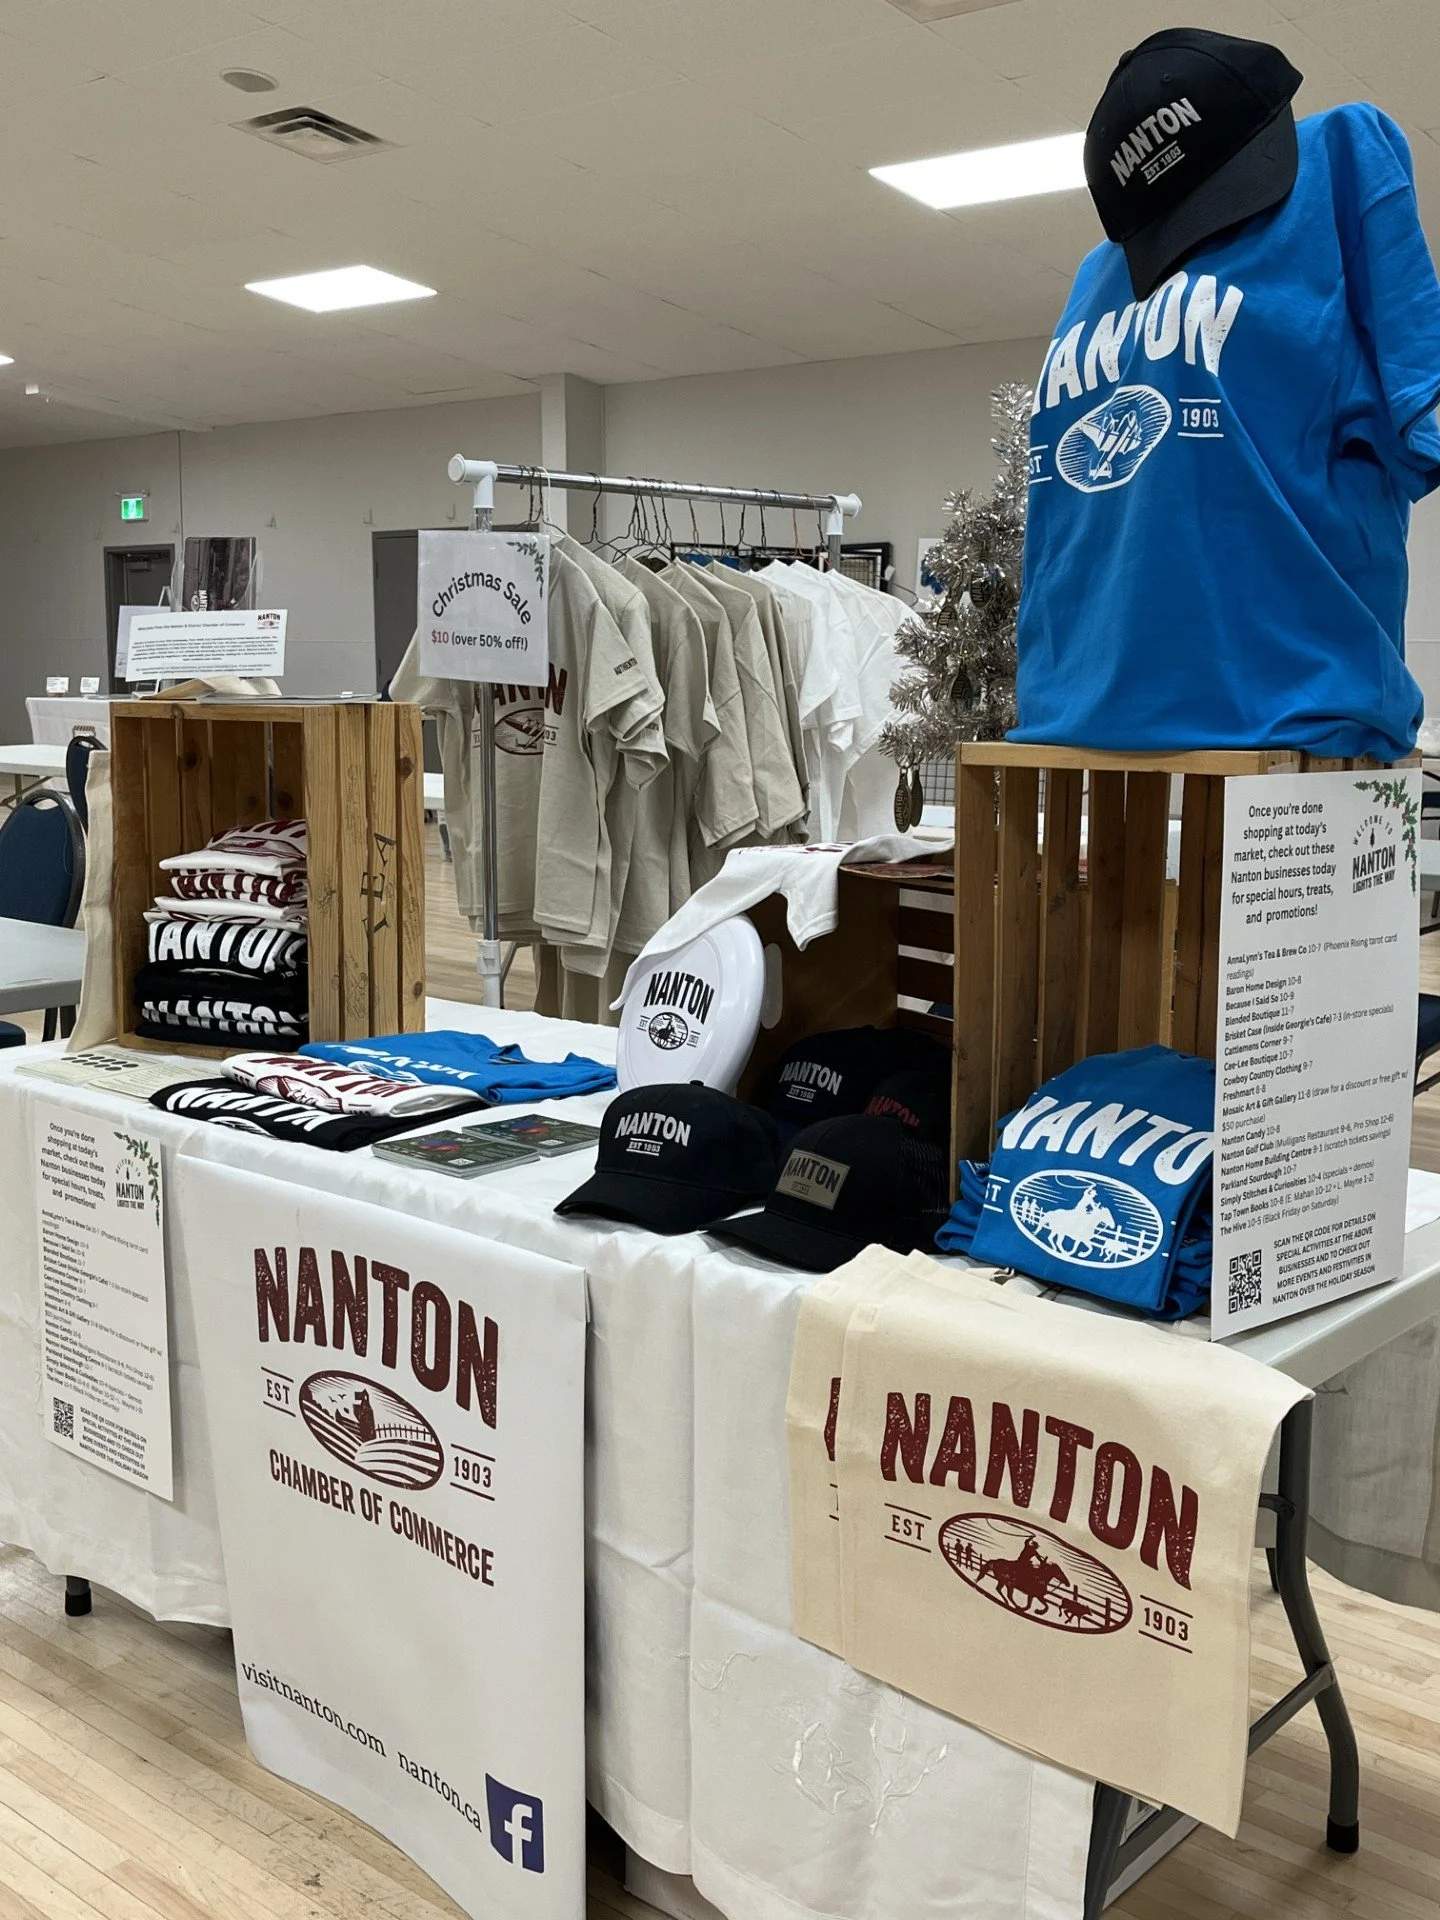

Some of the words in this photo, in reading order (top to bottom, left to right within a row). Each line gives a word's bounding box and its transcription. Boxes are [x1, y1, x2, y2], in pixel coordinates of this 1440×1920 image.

[1110, 98, 1201, 187] NANTON
[1144, 162, 1160, 180] EST
[1182, 408, 1218, 427] 1903
[432, 571, 502, 618] Christmas
[504, 582, 532, 625] Sale
[431, 630, 449, 644] $10
[452, 632, 476, 647] (over
[479, 633, 502, 648] 50%
[505, 636, 528, 651] off!)
[1248, 805, 1271, 817] Once
[1272, 803, 1299, 819] you're
[1301, 801, 1323, 814] done
[1243, 825, 1282, 841] shopping
[1284, 825, 1293, 836] at
[1295, 821, 1326, 837] today's
[1353, 814, 1382, 846] WELCOME
[1385, 822, 1393, 835] TO
[1234, 848, 1266, 861] market,
[1268, 844, 1293, 858] check
[1295, 844, 1310, 856] out
[1311, 842, 1334, 854] these
[1353, 845, 1396, 880] NANTON
[1231, 871, 1261, 883] Nanton
[1264, 866, 1310, 880] businesses
[1312, 862, 1336, 876] today
[1353, 877, 1372, 894] LIGHTS
[1373, 872, 1383, 886] THE
[1385, 870, 1396, 883] WAY
[1232, 891, 1244, 904] for
[1246, 887, 1276, 905] special
[1278, 887, 1304, 899] hours,
[1306, 883, 1333, 896] treats,
[1246, 910, 1262, 924] and
[1266, 904, 1317, 924] promotions!
[643, 971, 715, 1025] NANTON
[1226, 986, 1244, 996] Baron
[1245, 983, 1264, 992] Home
[1265, 979, 1286, 989] Design
[1287, 975, 1301, 986] 10-8
[1225, 1000, 1251, 1010] Because
[1252, 997, 1254, 1005] I
[1255, 995, 1269, 1005] Said
[1270, 994, 1278, 1003] So
[1279, 991, 1294, 1002] 10-9
[1225, 1012, 1250, 1026] Blended
[1251, 1009, 1280, 1021] Boutique
[1281, 1005, 1294, 1016] 11-7
[779, 1061, 842, 1095] NANTON
[1223, 1074, 1248, 1086] Cowboy
[1249, 1069, 1274, 1081] Country
[1275, 1063, 1301, 1075] Clothing
[1302, 1060, 1312, 1070] 9-7
[1222, 1087, 1254, 1101] Freshmart
[1255, 1083, 1266, 1094] 8-8
[615, 1112, 691, 1147] NANTON
[1221, 1134, 1244, 1146] Nanton
[1245, 1128, 1265, 1140] Candy
[1266, 1124, 1280, 1136] 10-8
[644, 1144, 660, 1153] 1903
[783, 1157, 840, 1193] NANTON
[116, 1183, 144, 1200] NANTON
[1220, 1212, 1232, 1221] Tap
[1233, 1207, 1249, 1217] Town
[1250, 1200, 1269, 1212] Books
[1273, 1237, 1290, 1248] SCAN
[1291, 1232, 1303, 1242] THE
[1304, 1230, 1313, 1241] QR
[1314, 1225, 1330, 1236] CODE
[1331, 1221, 1343, 1231] FOR
[1343, 1214, 1366, 1228] DETAILS
[1367, 1213, 1375, 1221] ON
[1276, 1248, 1301, 1261] SPECIAL
[1301, 1238, 1333, 1254] ACTIVITIES
[1334, 1235, 1341, 1244] AT
[1342, 1231, 1353, 1242] THE
[1354, 1225, 1372, 1238] ABOVE
[1278, 1256, 1314, 1274] BUSINESSES
[1315, 1252, 1329, 1262] AND
[1329, 1249, 1337, 1258] TO
[1338, 1243, 1357, 1256] CHECK
[1358, 1239, 1370, 1250] OUT
[1272, 1290, 1298, 1303] NANTON
[1299, 1284, 1315, 1296] OVER
[1316, 1280, 1327, 1290] THE
[1328, 1272, 1352, 1285] HOLIDAY
[1353, 1264, 1375, 1278] SEASON
[1277, 1276, 1294, 1289] MORE
[1295, 1269, 1318, 1283] EVENTS
[1318, 1265, 1332, 1276] AND
[1332, 1254, 1364, 1271] FESTIVITIES
[1365, 1252, 1371, 1261] IN
[254, 1247, 498, 1430] NANTON
[267, 1378, 290, 1405] EST
[454, 1456, 492, 1487] 1903
[880, 1392, 1199, 1590] NANTON
[270, 1449, 355, 1515] CHAMBER
[359, 1487, 383, 1525] OF
[390, 1500, 495, 1587] COMMERCE
[891, 1514, 925, 1541] EST
[1144, 1607, 1189, 1642] 1903
[242, 1663, 387, 1757] visitnanton.com
[397, 1751, 482, 1833] nanton.ca
